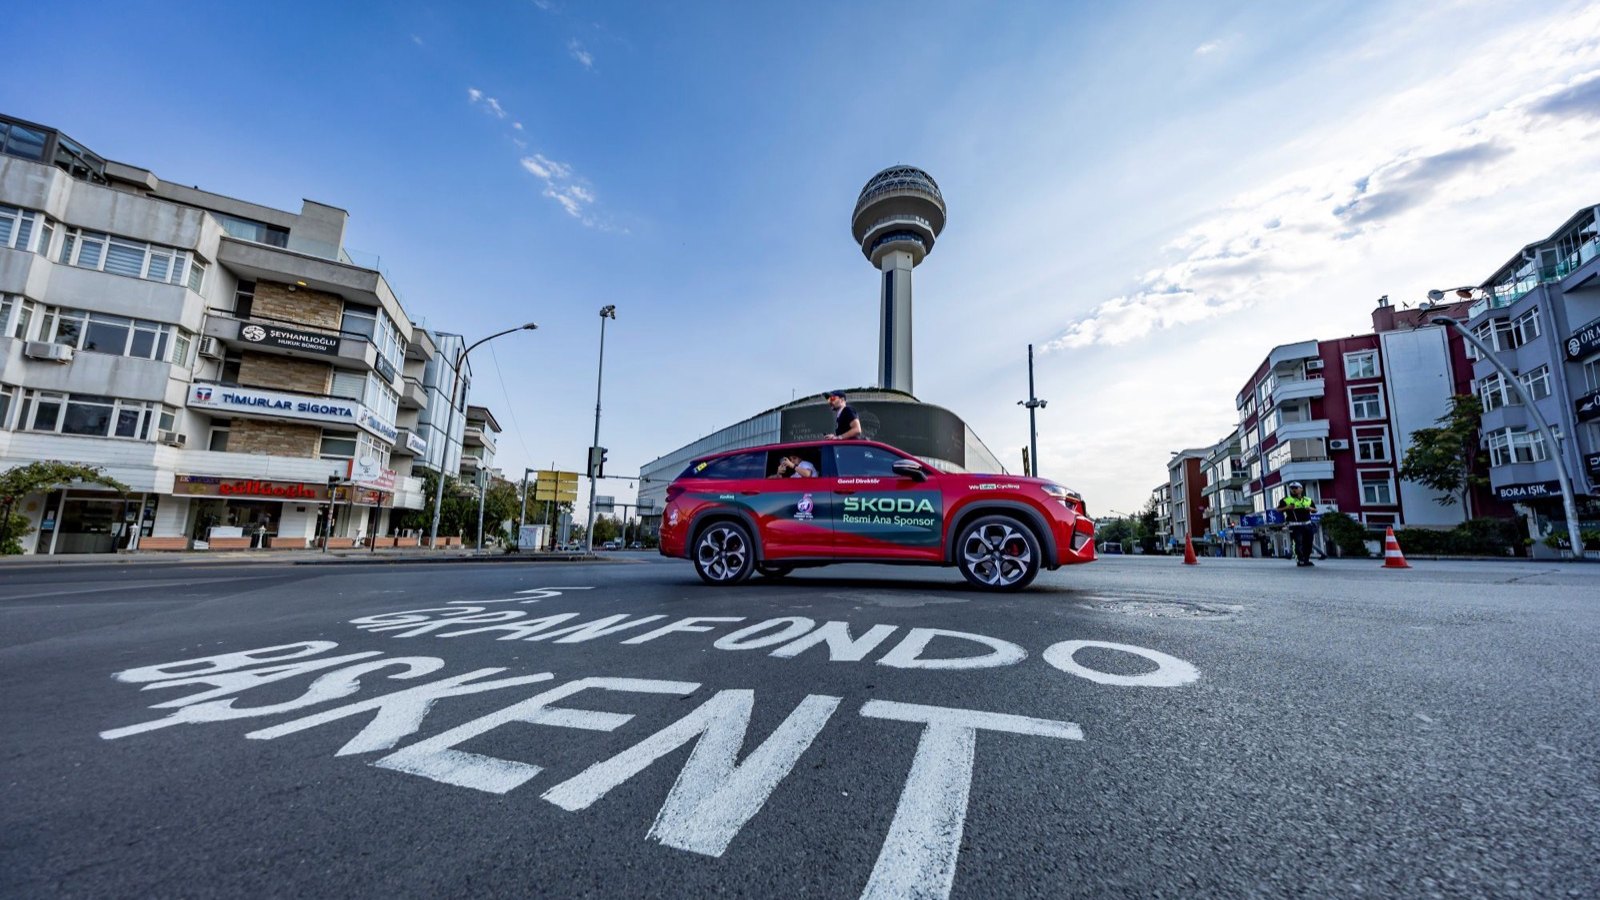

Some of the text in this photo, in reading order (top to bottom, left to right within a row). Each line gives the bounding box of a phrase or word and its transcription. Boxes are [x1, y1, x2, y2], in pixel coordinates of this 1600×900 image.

[278, 339, 300, 347] HUKUK
[222, 392, 353, 417] TİMURLAR SİGORTA
[1500, 487, 1527, 498] BORA
[1528, 484, 1547, 496] IŞIK
[843, 514, 935, 527] Resmi Ana Sponsor
